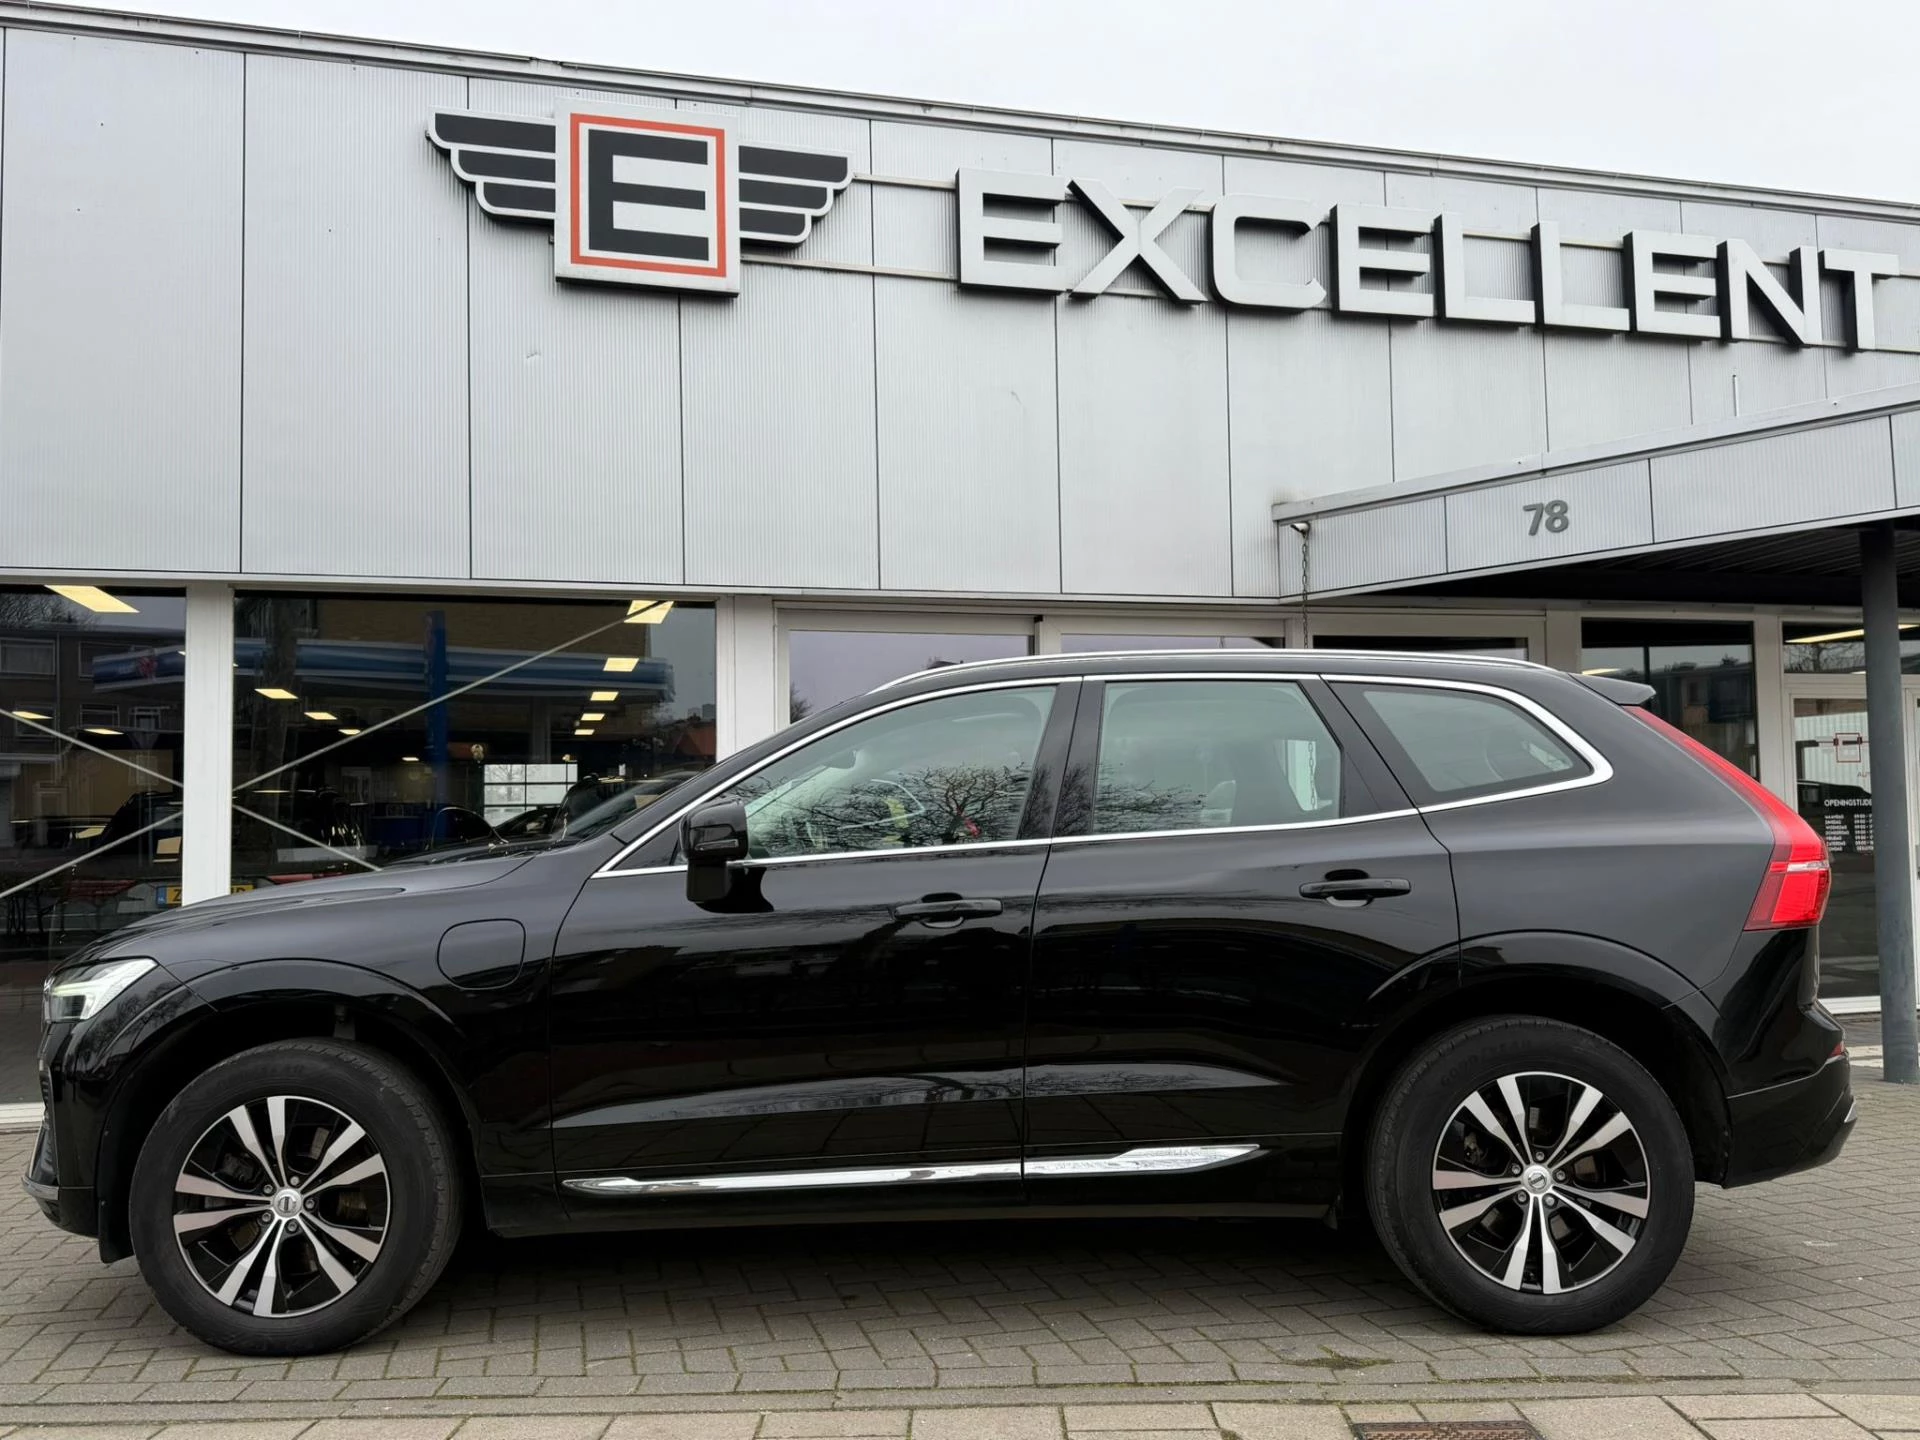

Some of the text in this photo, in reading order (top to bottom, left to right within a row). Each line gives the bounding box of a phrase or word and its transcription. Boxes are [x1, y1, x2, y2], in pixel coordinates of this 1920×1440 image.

[588, 129, 709, 261] E
[956, 168, 1900, 352] EXCELLENT
[1523, 500, 1569, 536] 78
